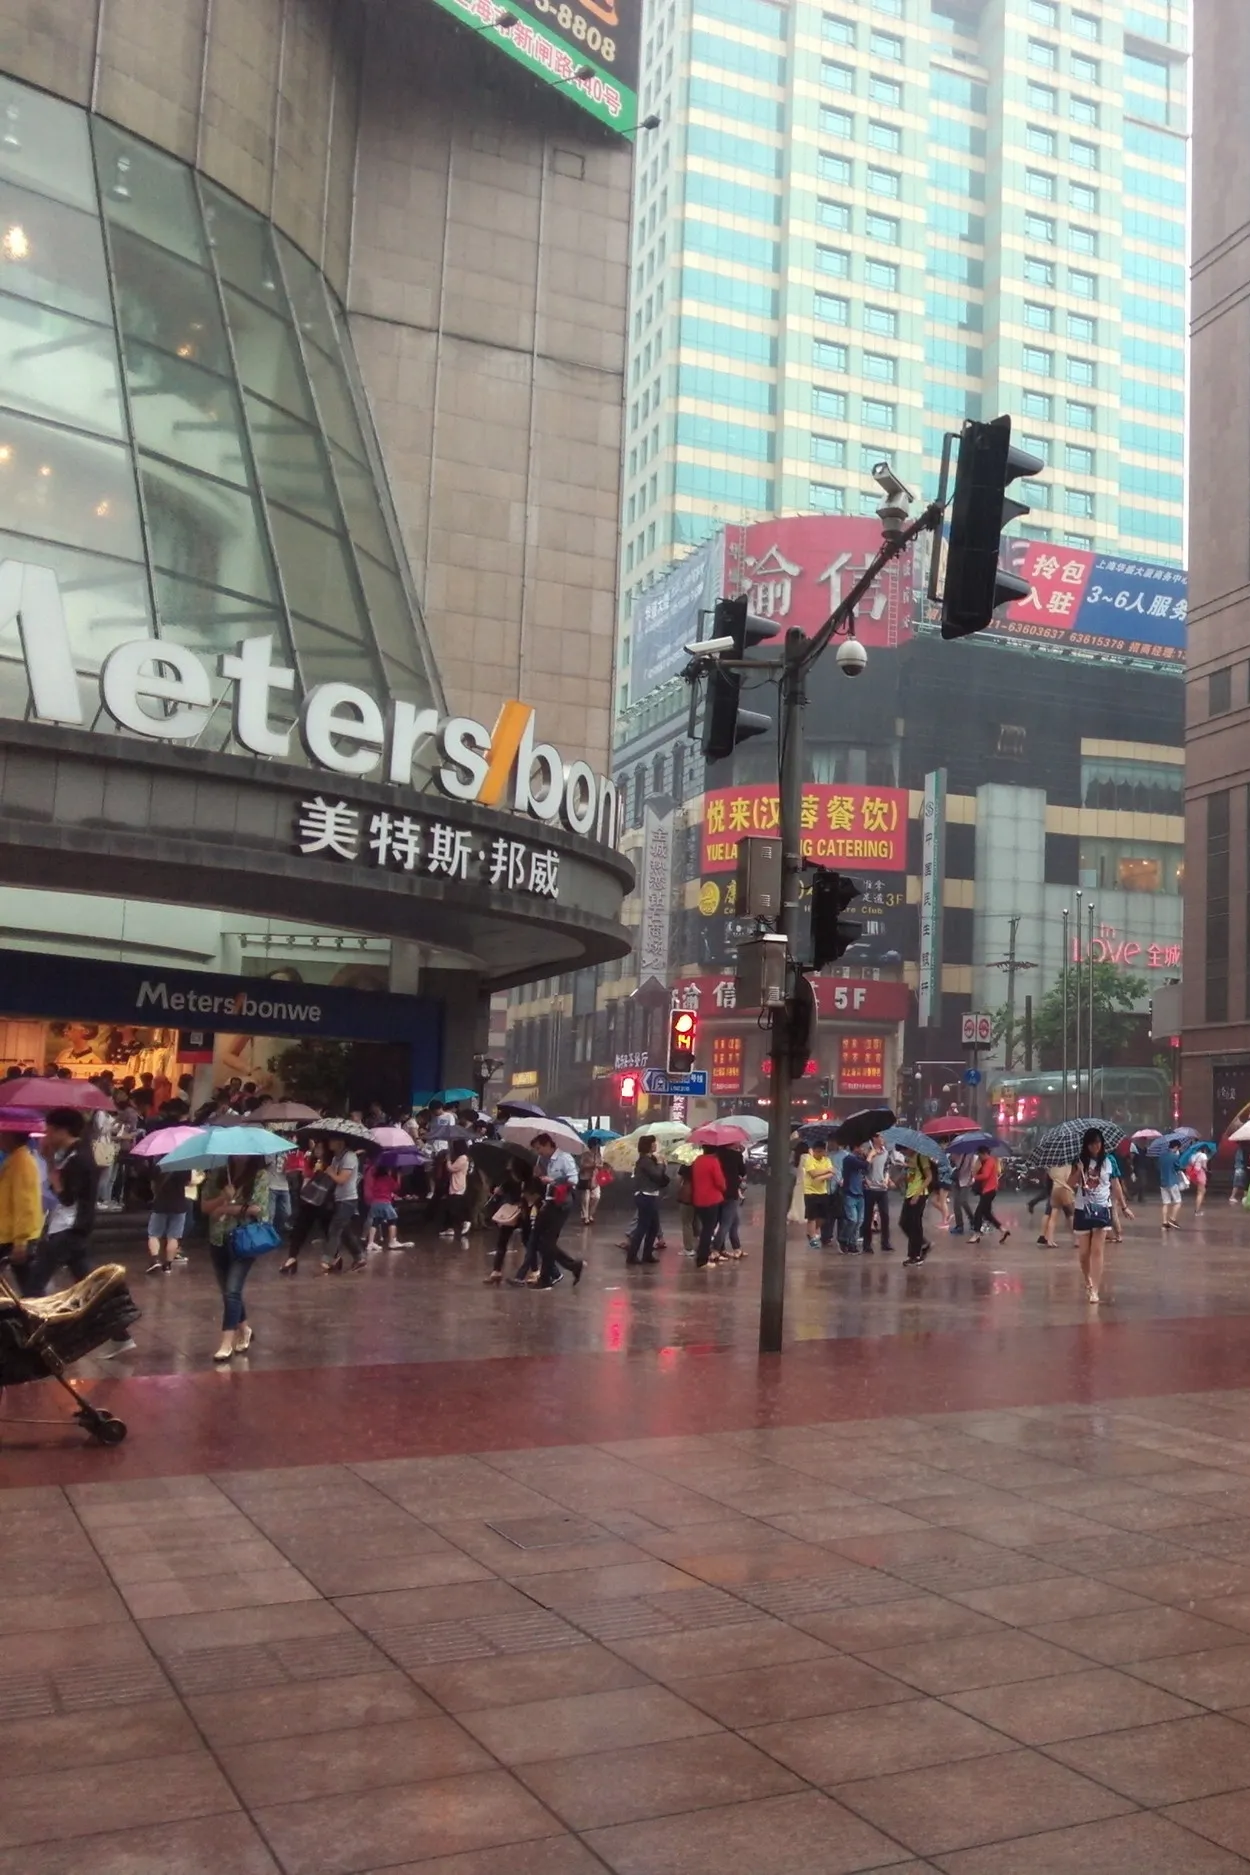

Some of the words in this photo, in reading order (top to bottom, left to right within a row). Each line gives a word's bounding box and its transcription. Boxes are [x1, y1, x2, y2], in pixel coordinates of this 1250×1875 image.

[1032, 554, 1087, 584] 拎包
[1018, 587, 1075, 615] 入驻
[817, 839, 894, 860] CATERING)
[1146, 942, 1182, 967] 全城
[834, 987, 867, 1010] 5F
[677, 1034, 691, 1050] 14
